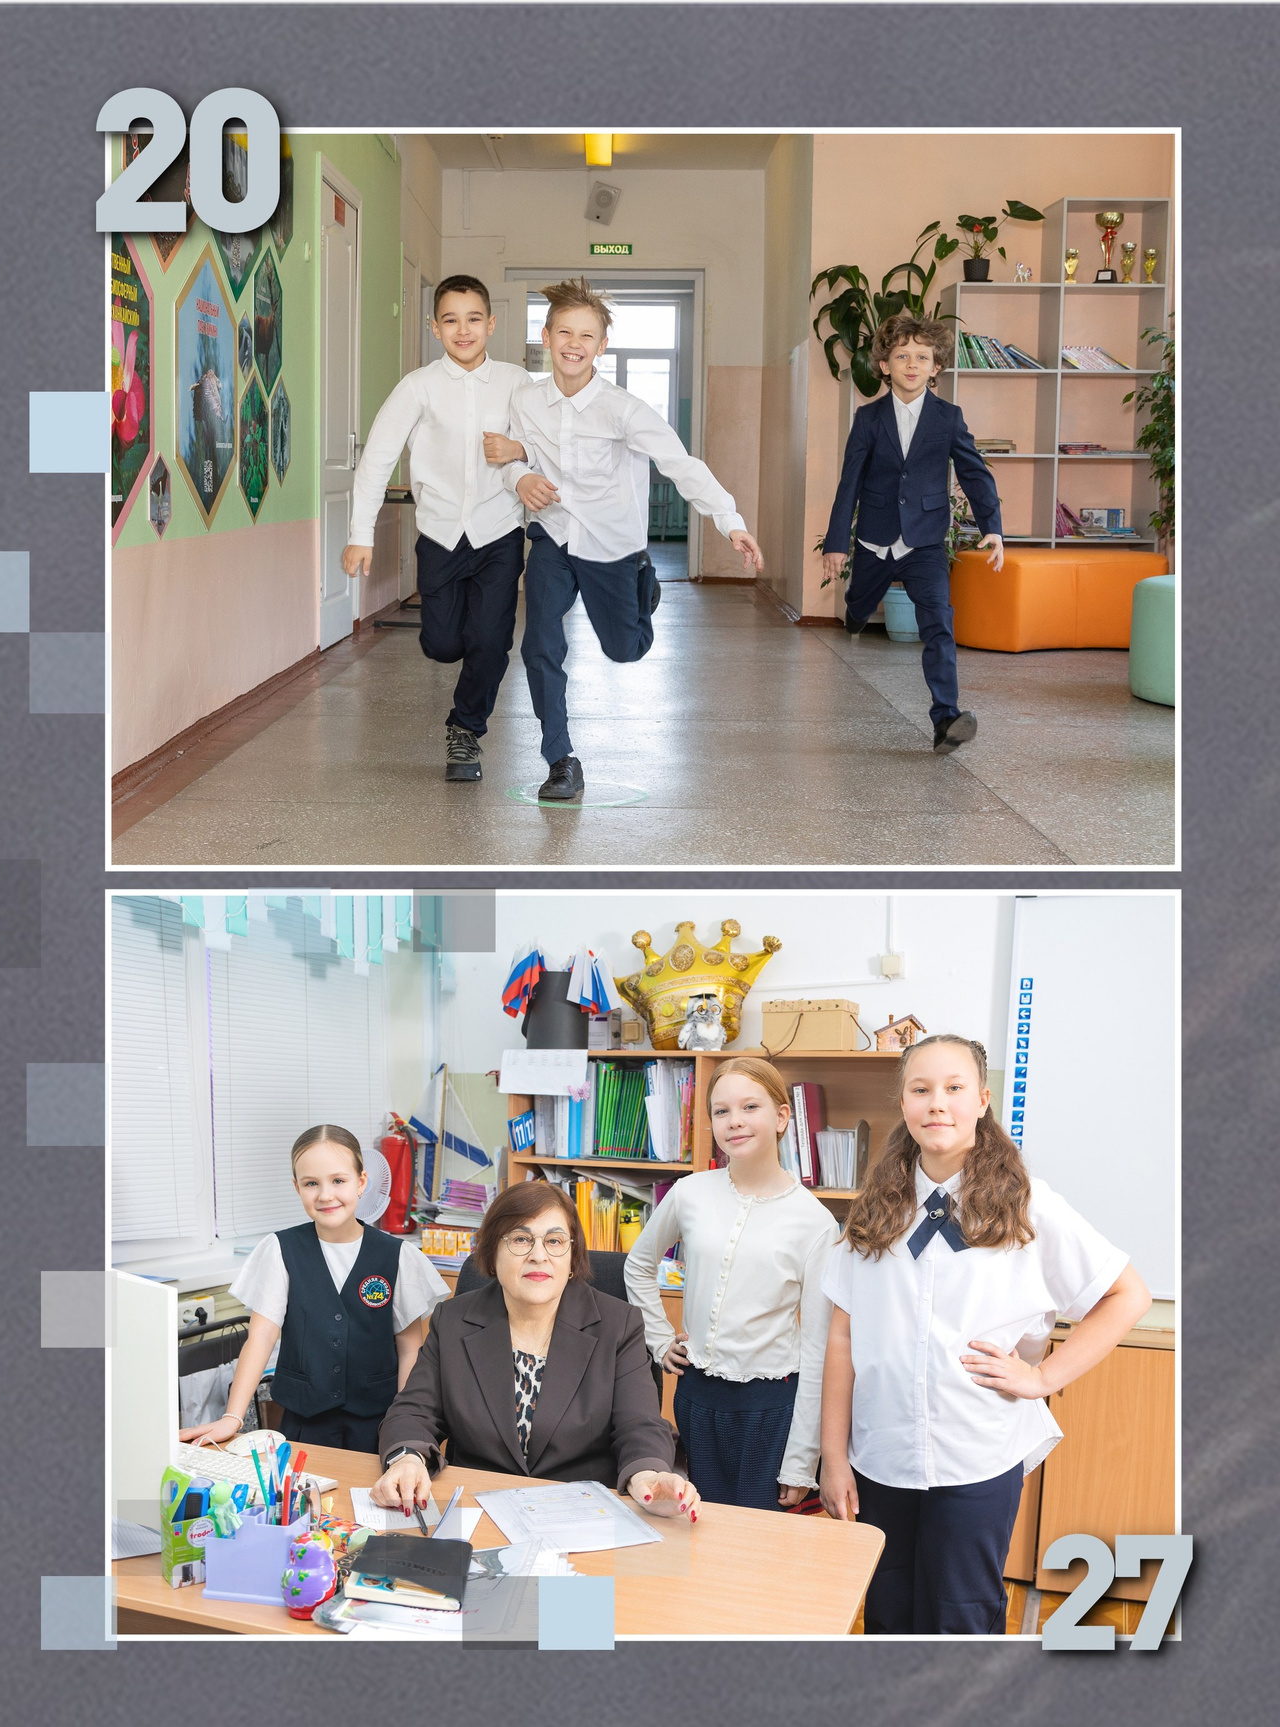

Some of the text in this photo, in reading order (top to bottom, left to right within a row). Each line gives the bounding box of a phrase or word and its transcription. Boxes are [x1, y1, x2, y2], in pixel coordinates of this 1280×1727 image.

[593, 244, 630, 255] ВЫХОД
[515, 1123, 526, 1147] 11
[525, 1118, 535, 1143] 12
[189, 1528, 214, 1539] trod
